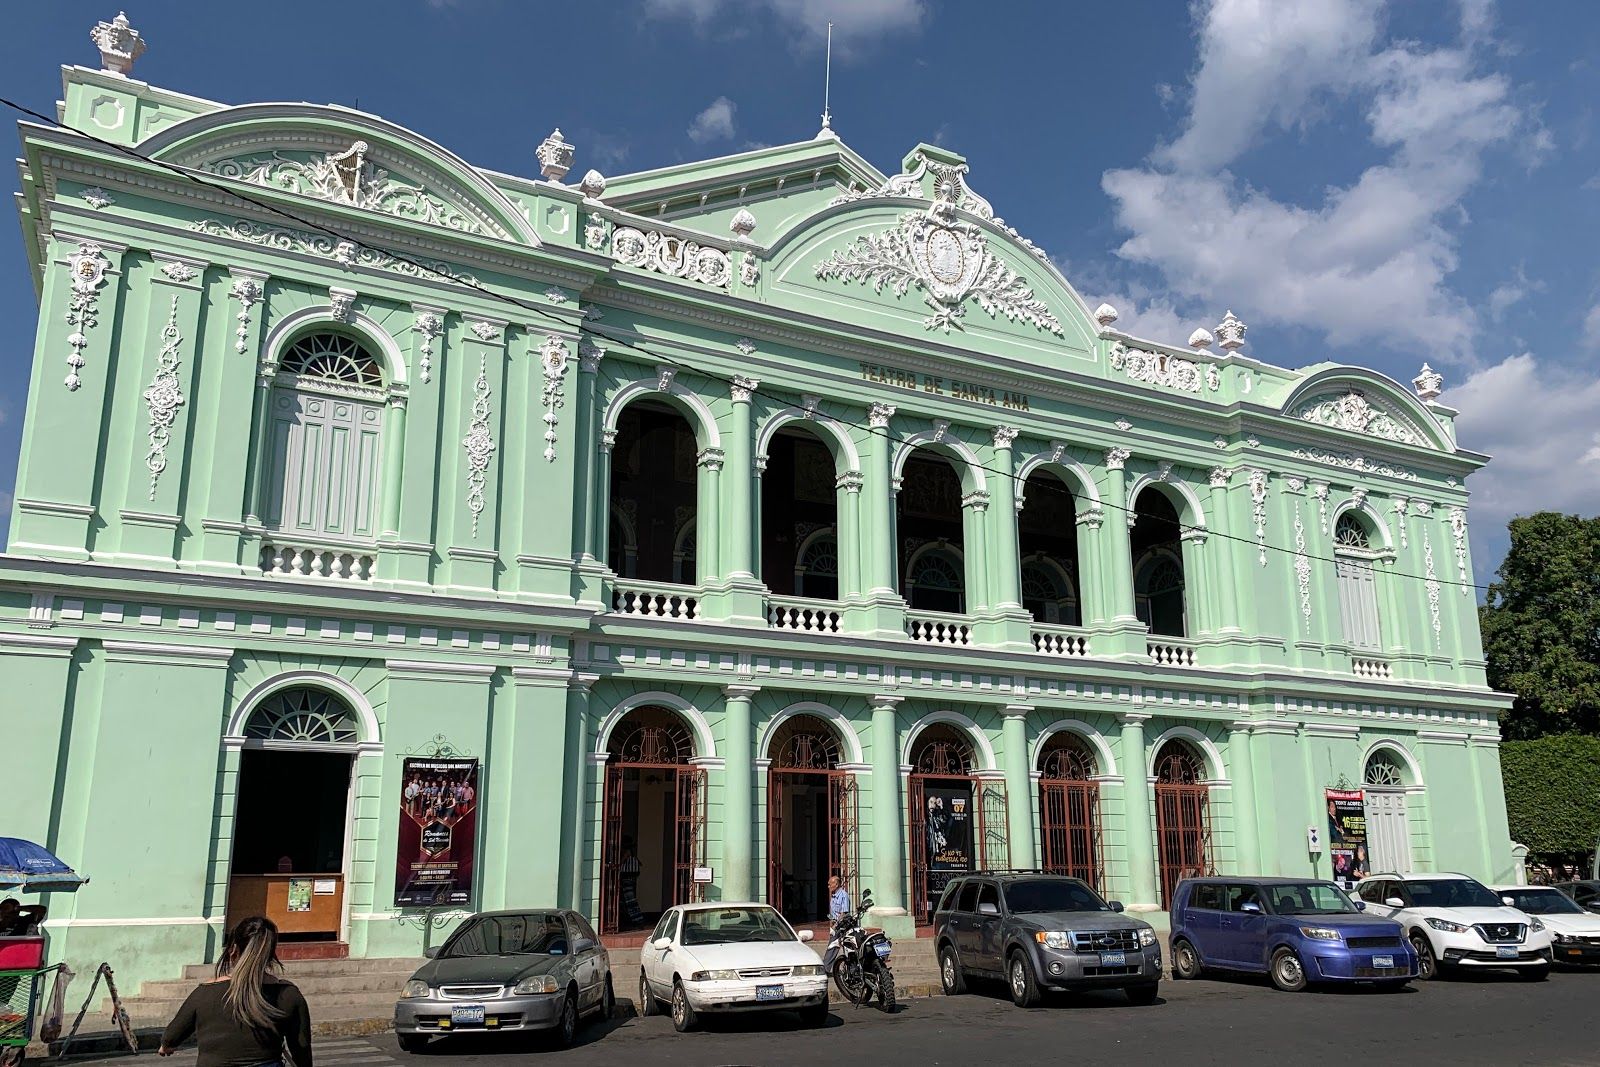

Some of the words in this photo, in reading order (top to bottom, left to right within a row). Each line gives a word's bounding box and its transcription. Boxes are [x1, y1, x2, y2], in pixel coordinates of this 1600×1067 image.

[860, 363, 916, 389] TEATRO
[924, 376, 944, 395] DE
[951, 380, 997, 406] SANTA
[1003, 391, 1030, 412] ANA
[953, 804, 965, 813] 07
